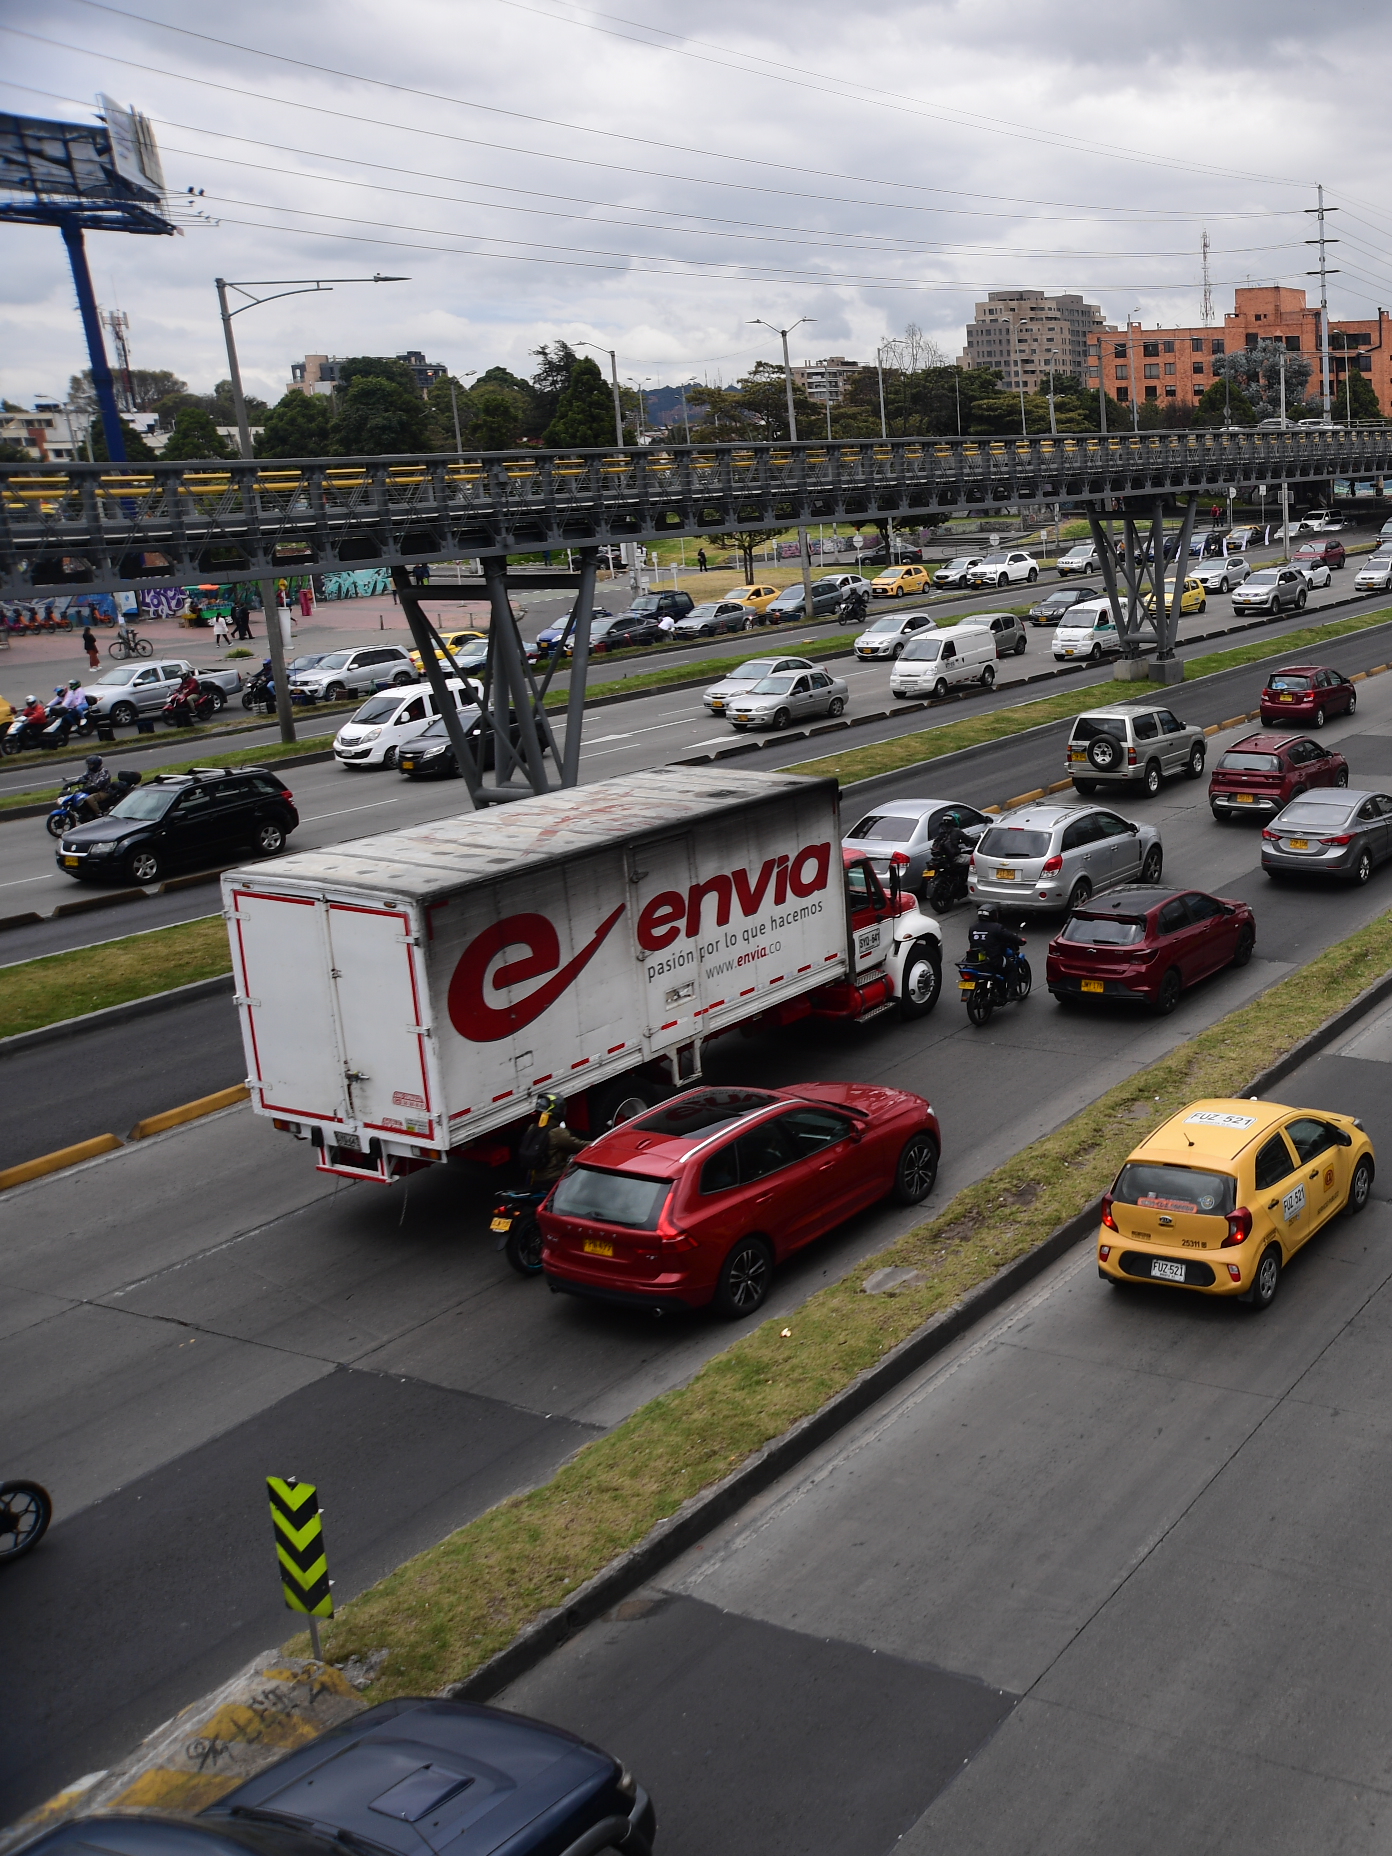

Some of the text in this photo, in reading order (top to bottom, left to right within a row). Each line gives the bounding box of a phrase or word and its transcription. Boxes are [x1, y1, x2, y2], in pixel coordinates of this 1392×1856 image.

[648, 901, 823, 983] pasión por lo que hacemos
[705, 940, 782, 979] www.envia.co
[1182, 1239, 1200, 1248] 25311
[1153, 1261, 1184, 1277] FUZ-521
